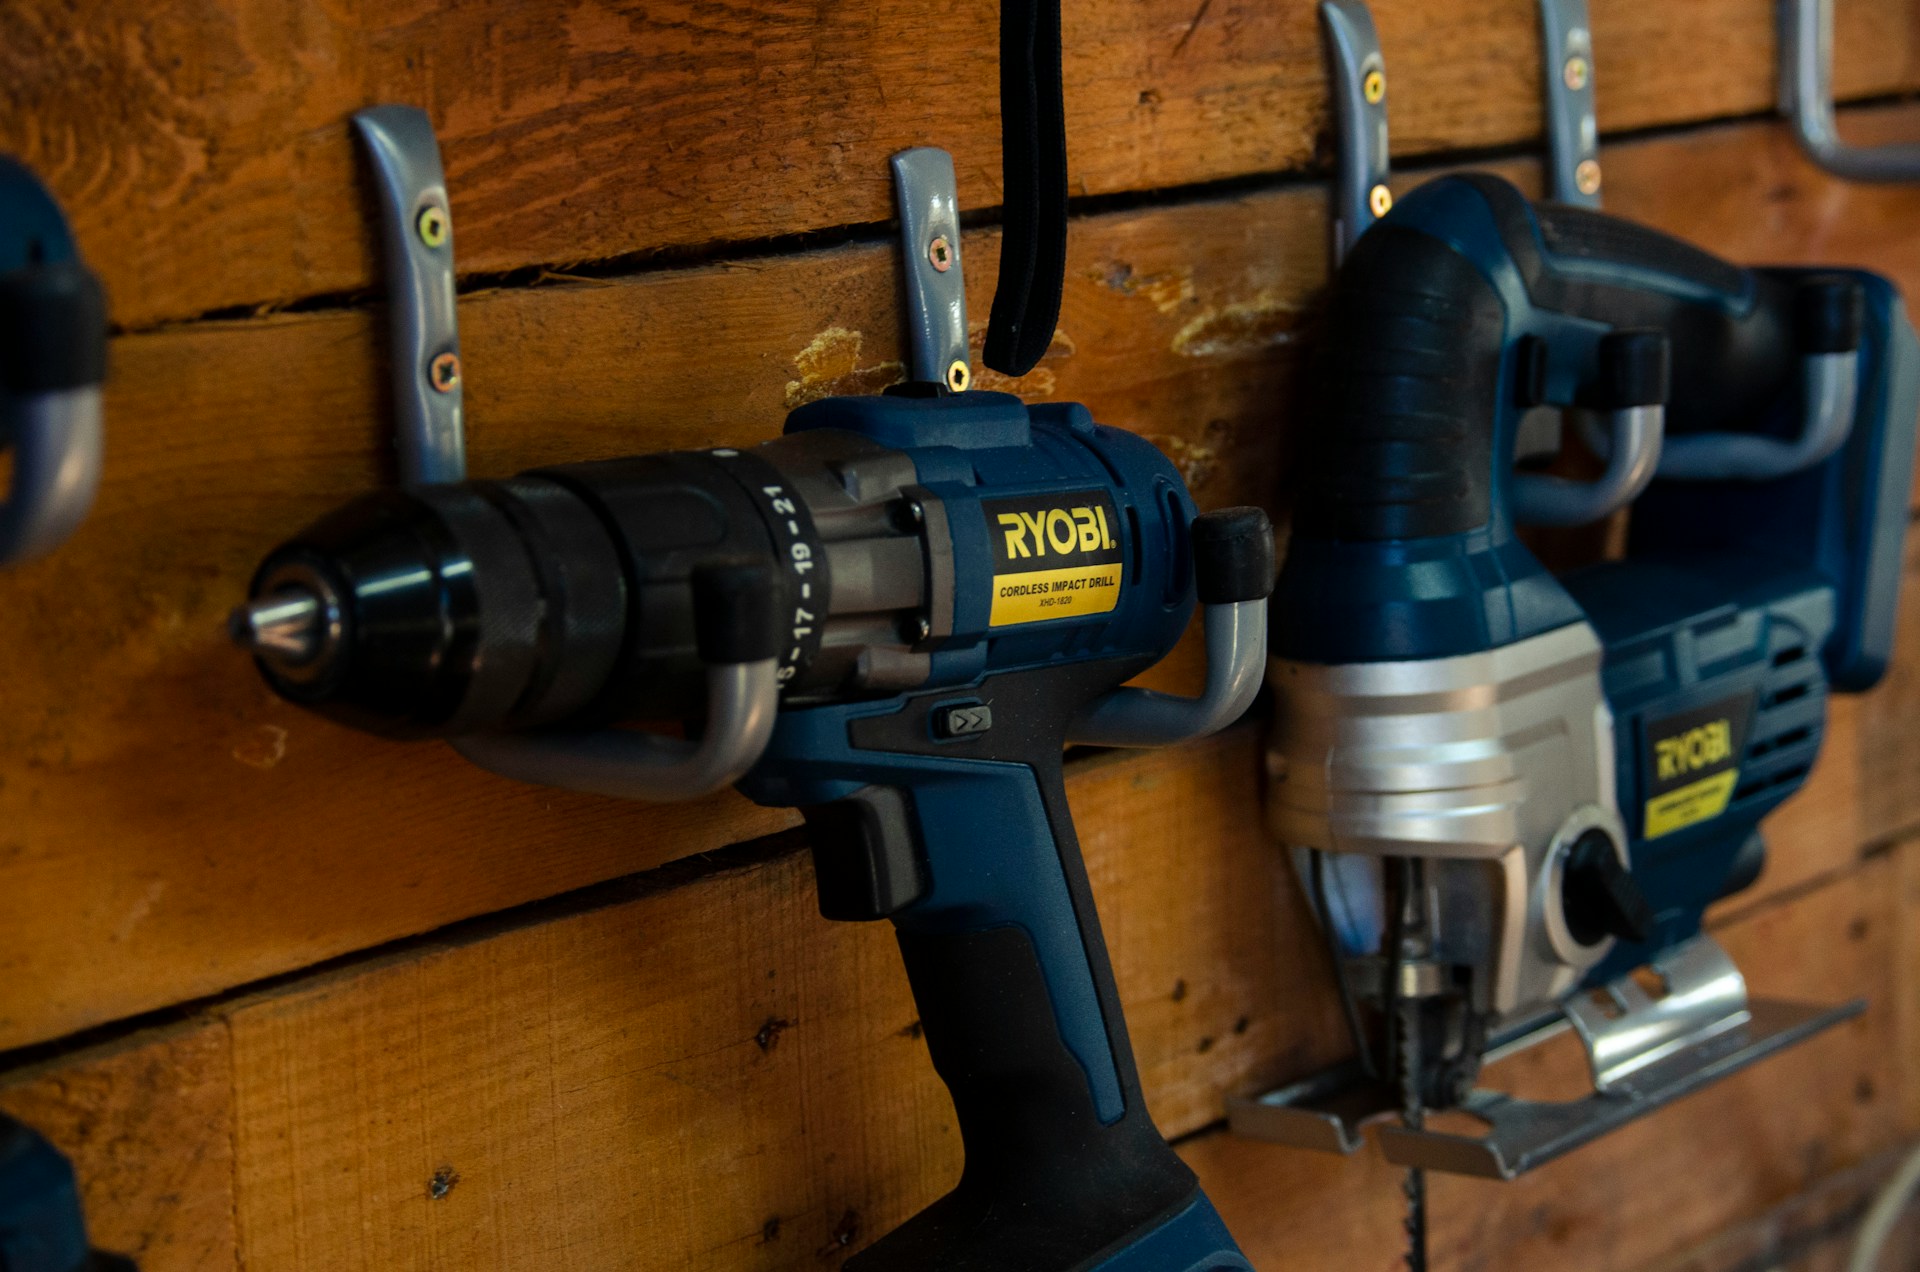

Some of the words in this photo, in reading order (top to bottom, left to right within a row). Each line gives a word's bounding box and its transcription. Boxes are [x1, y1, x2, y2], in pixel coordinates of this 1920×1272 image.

[763, 486, 796, 514] 21
[997, 505, 1110, 559] RYOBI
[792, 542, 813, 574] 19
[1000, 582, 1049, 598] CORDLESS
[1051, 578, 1087, 592] IMPACT
[1088, 575, 1115, 588] DRILL
[793, 608, 814, 640] 17
[1655, 718, 1731, 778] RYOBI
